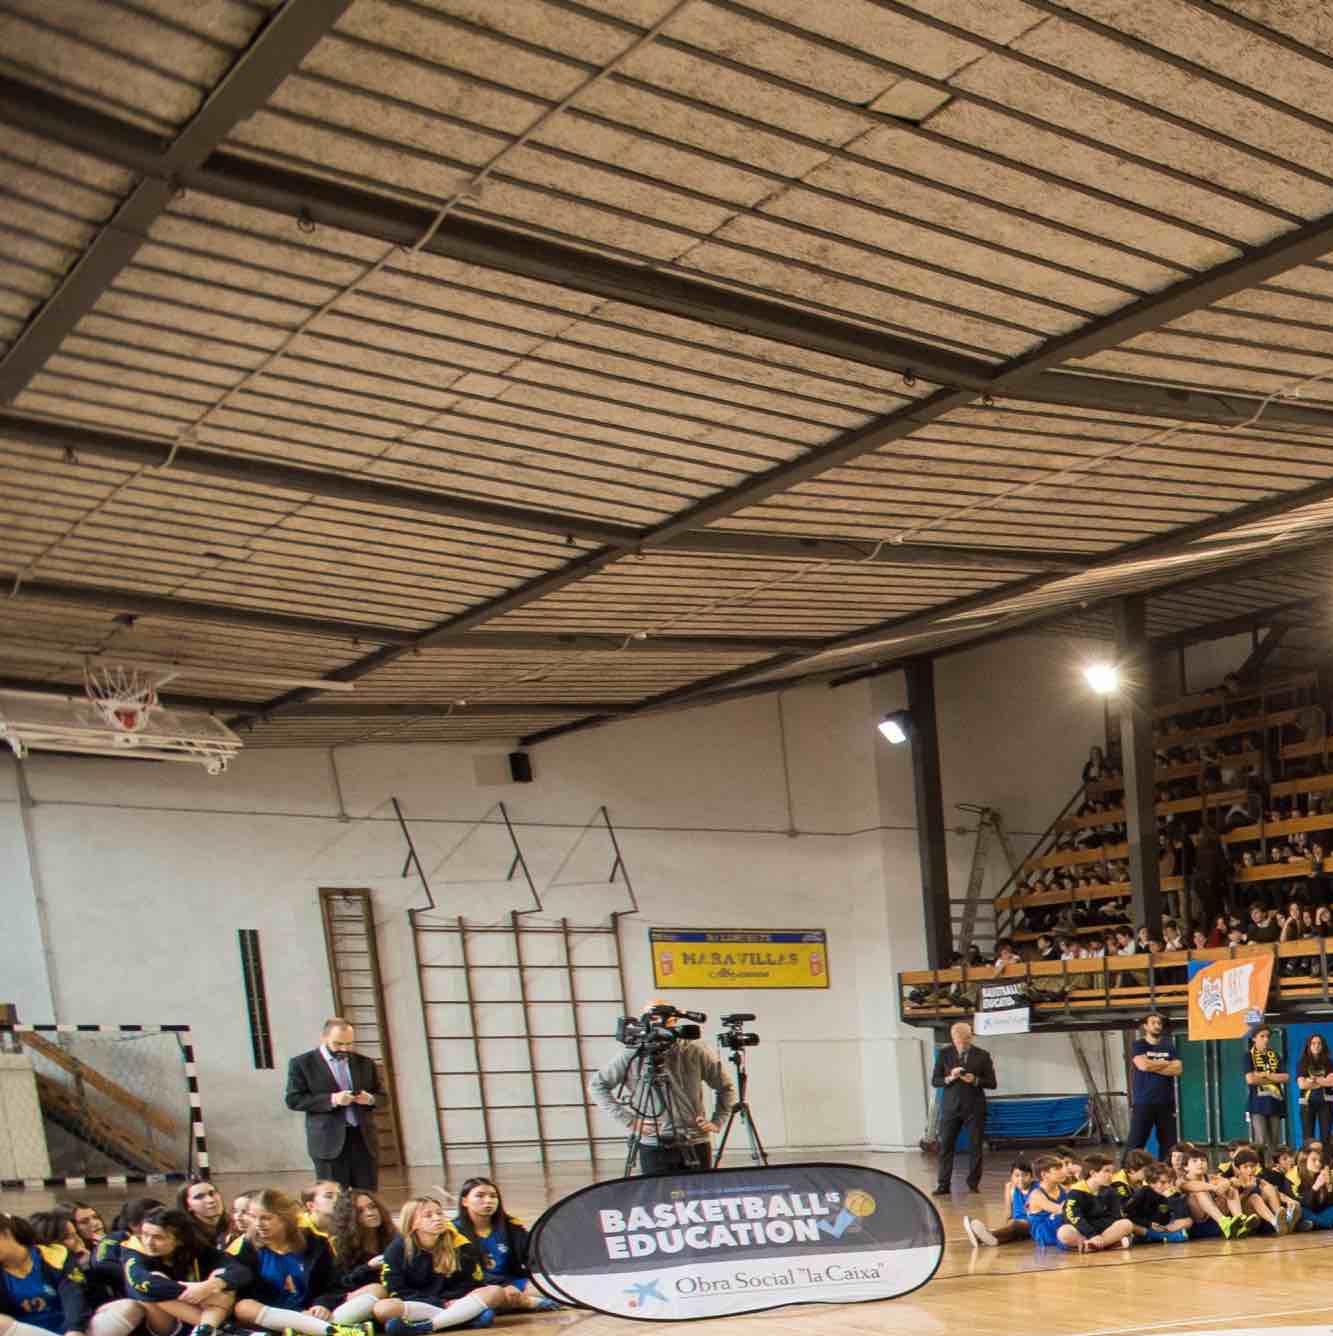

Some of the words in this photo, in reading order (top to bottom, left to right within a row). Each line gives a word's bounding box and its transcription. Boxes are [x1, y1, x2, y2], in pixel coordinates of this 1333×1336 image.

[601, 1192, 829, 1234] BASKETBALL
[826, 1191, 842, 1204] IS
[605, 1217, 821, 1260] EDUCATION
[675, 1276, 730, 1296] Obra
[735, 1268, 795, 1288] Social
[824, 1263, 885, 1283] Caixa"
